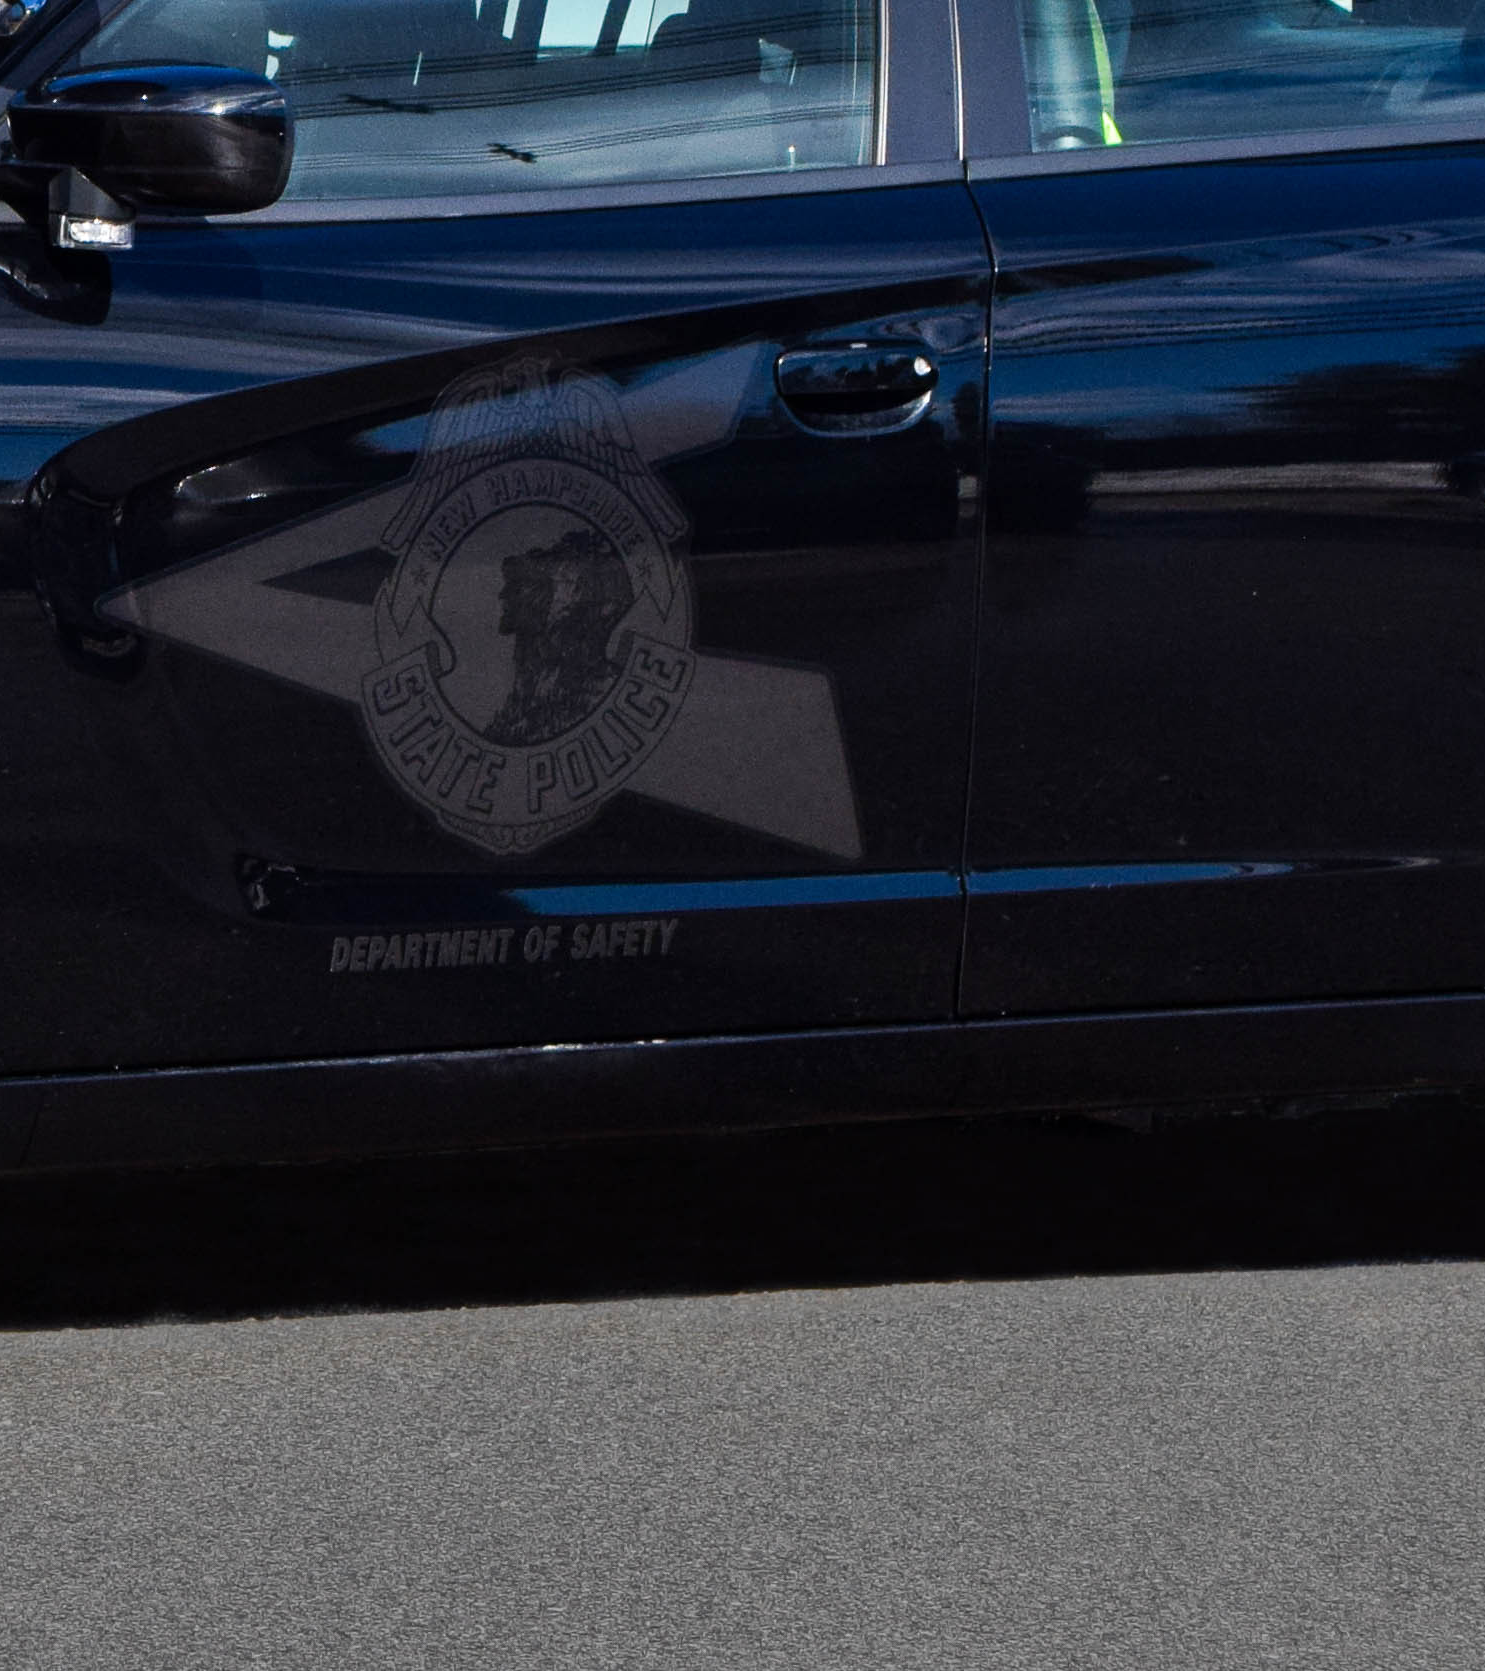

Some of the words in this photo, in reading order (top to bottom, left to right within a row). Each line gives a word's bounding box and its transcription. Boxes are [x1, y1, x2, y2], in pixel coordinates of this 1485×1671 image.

[421, 491, 478, 562] NEW
[485, 466, 646, 554] HAMPSHIRE
[372, 663, 508, 815] STATE
[526, 648, 687, 815] POLICE
[330, 929, 510, 974] DEPARTMENT
[522, 926, 561, 962] OF
[570, 919, 678, 961] SAFETY
